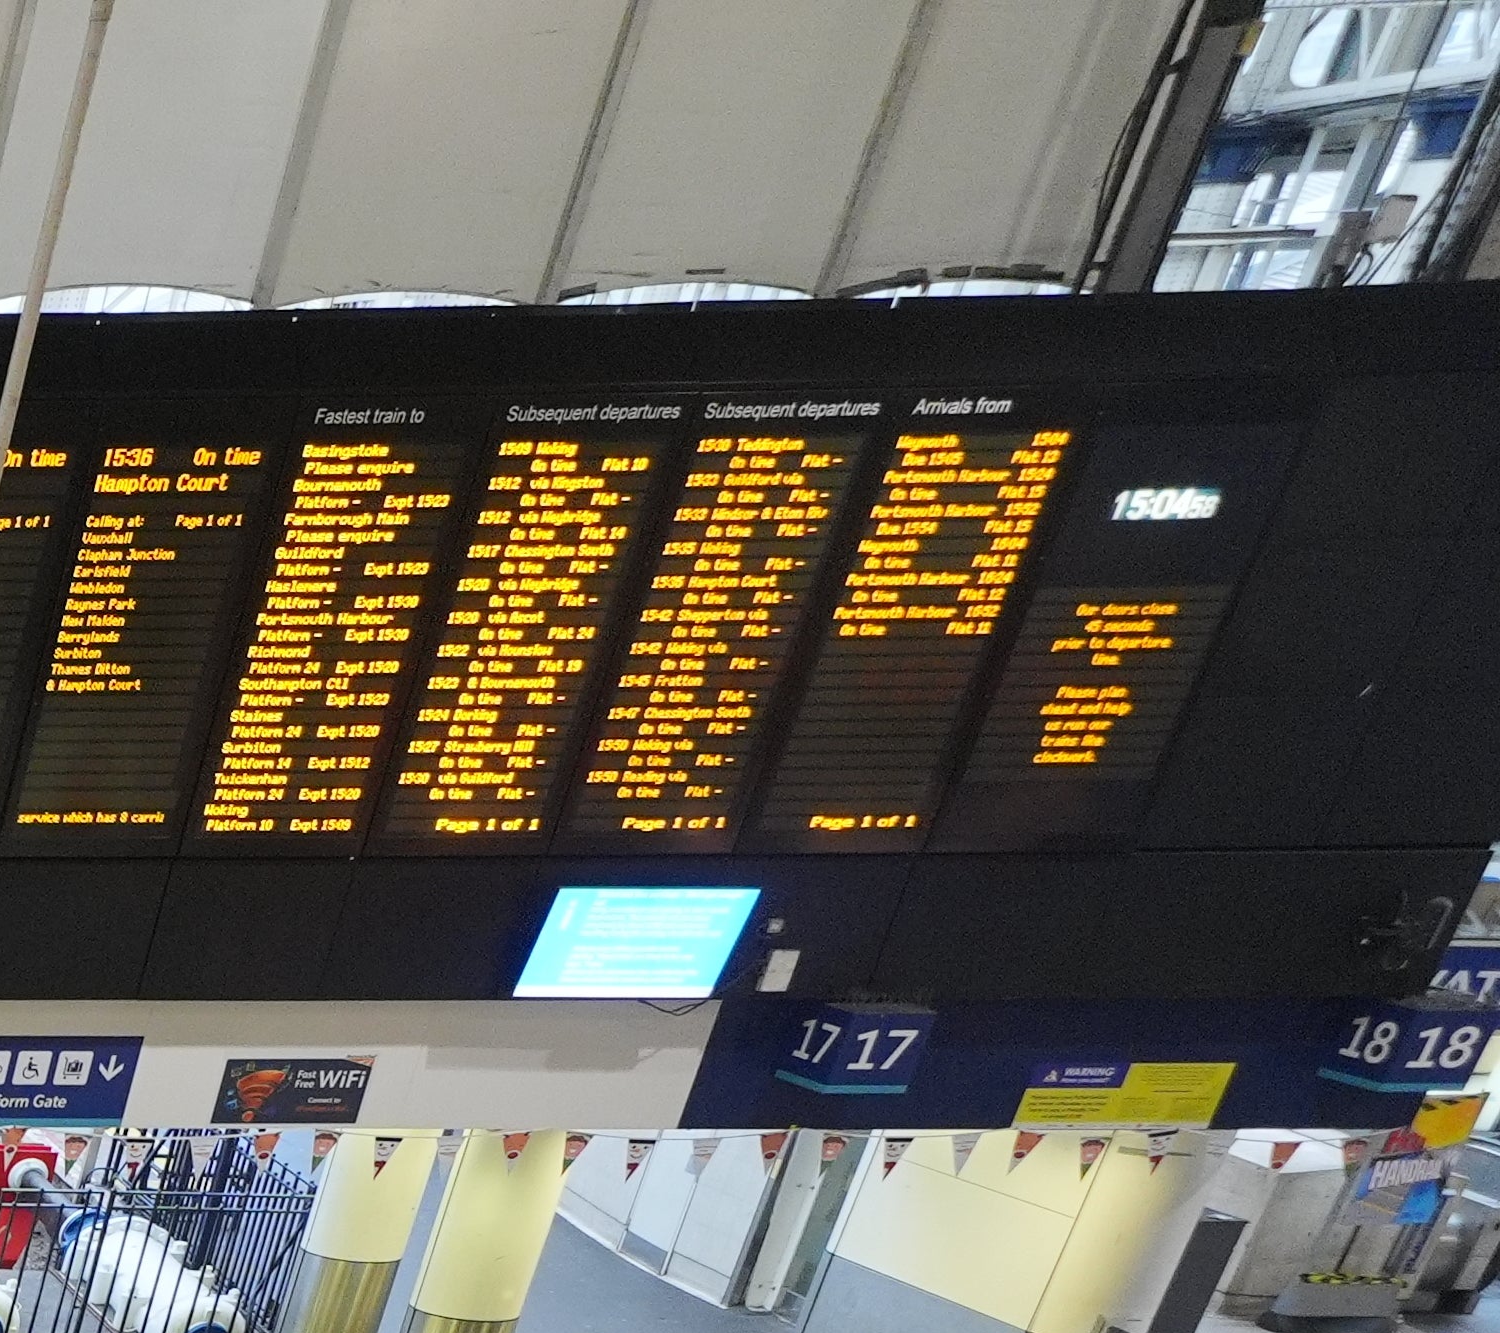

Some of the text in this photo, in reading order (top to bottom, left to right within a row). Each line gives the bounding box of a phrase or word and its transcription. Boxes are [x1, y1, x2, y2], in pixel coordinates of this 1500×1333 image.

[506, 405, 681, 424] Subsequent departures
[704, 400, 880, 421] Subsequent departures
[912, 397, 1012, 416] Arrivals from
[314, 408, 425, 425] Fastest train to
[32, 449, 66, 466] time
[105, 448, 261, 466] 15:36 On time
[303, 444, 389, 460] Basingstoke
[357, 461, 414, 476] enquire
[95, 474, 228, 494] Hampton Court
[791, 1018, 841, 1065] 17
[1338, 1016, 1400, 1064] 18
[1405, 1026, 1482, 1068] 18
[846, 1029, 919, 1073] 17
[296, 1069, 317, 1079] Fast
[319, 1069, 367, 1089] WiFi
[1064, 1067, 1116, 1077] WARNING
[294, 1079, 316, 1089] Free
[33, 1094, 67, 1109] Gate
